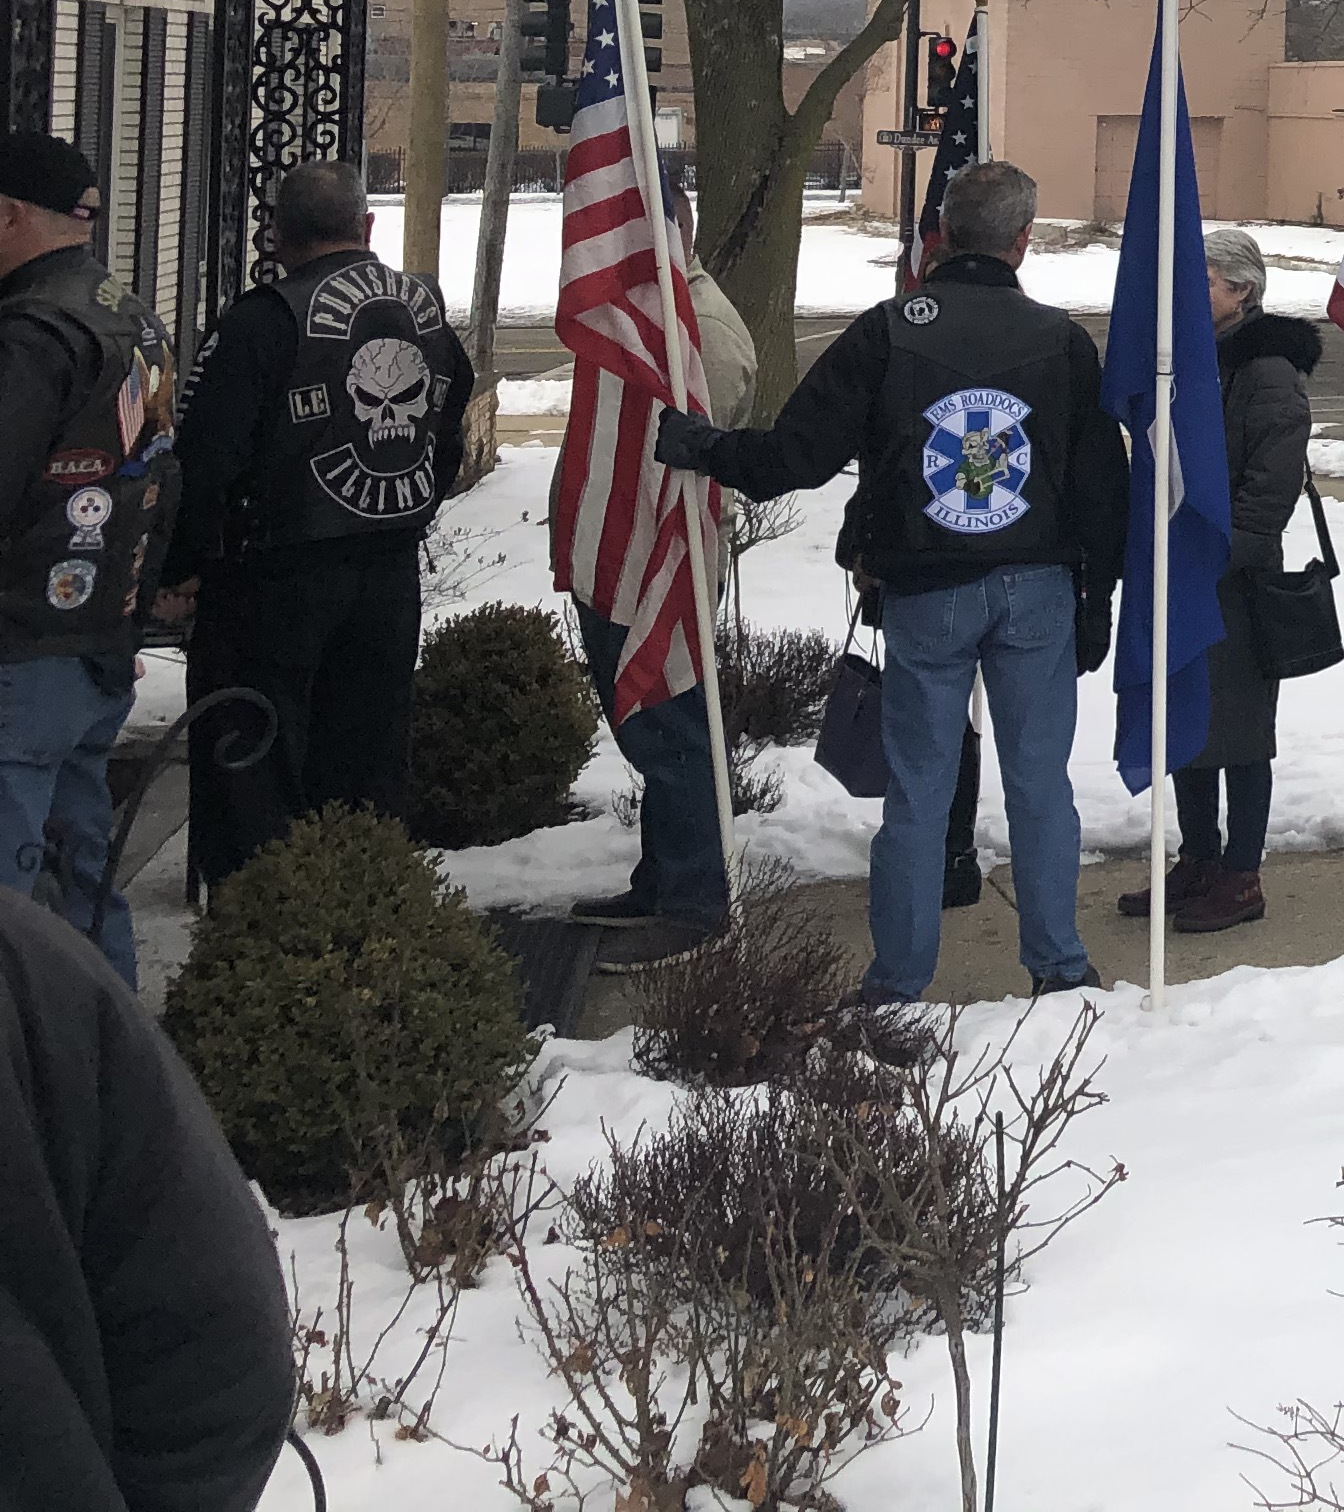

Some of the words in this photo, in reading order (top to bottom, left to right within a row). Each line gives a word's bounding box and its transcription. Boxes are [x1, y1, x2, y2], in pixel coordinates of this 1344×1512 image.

[894, 133, 925, 144] Dundee
[312, 264, 437, 330] PUNISHERS
[930, 399, 957, 421] EMS
[960, 392, 1024, 418] ROADDOCS
[926, 454, 939, 468] R
[1016, 452, 1028, 466] C
[325, 445, 434, 512] ILLINOI
[934, 504, 1019, 528] ILLINOIS
